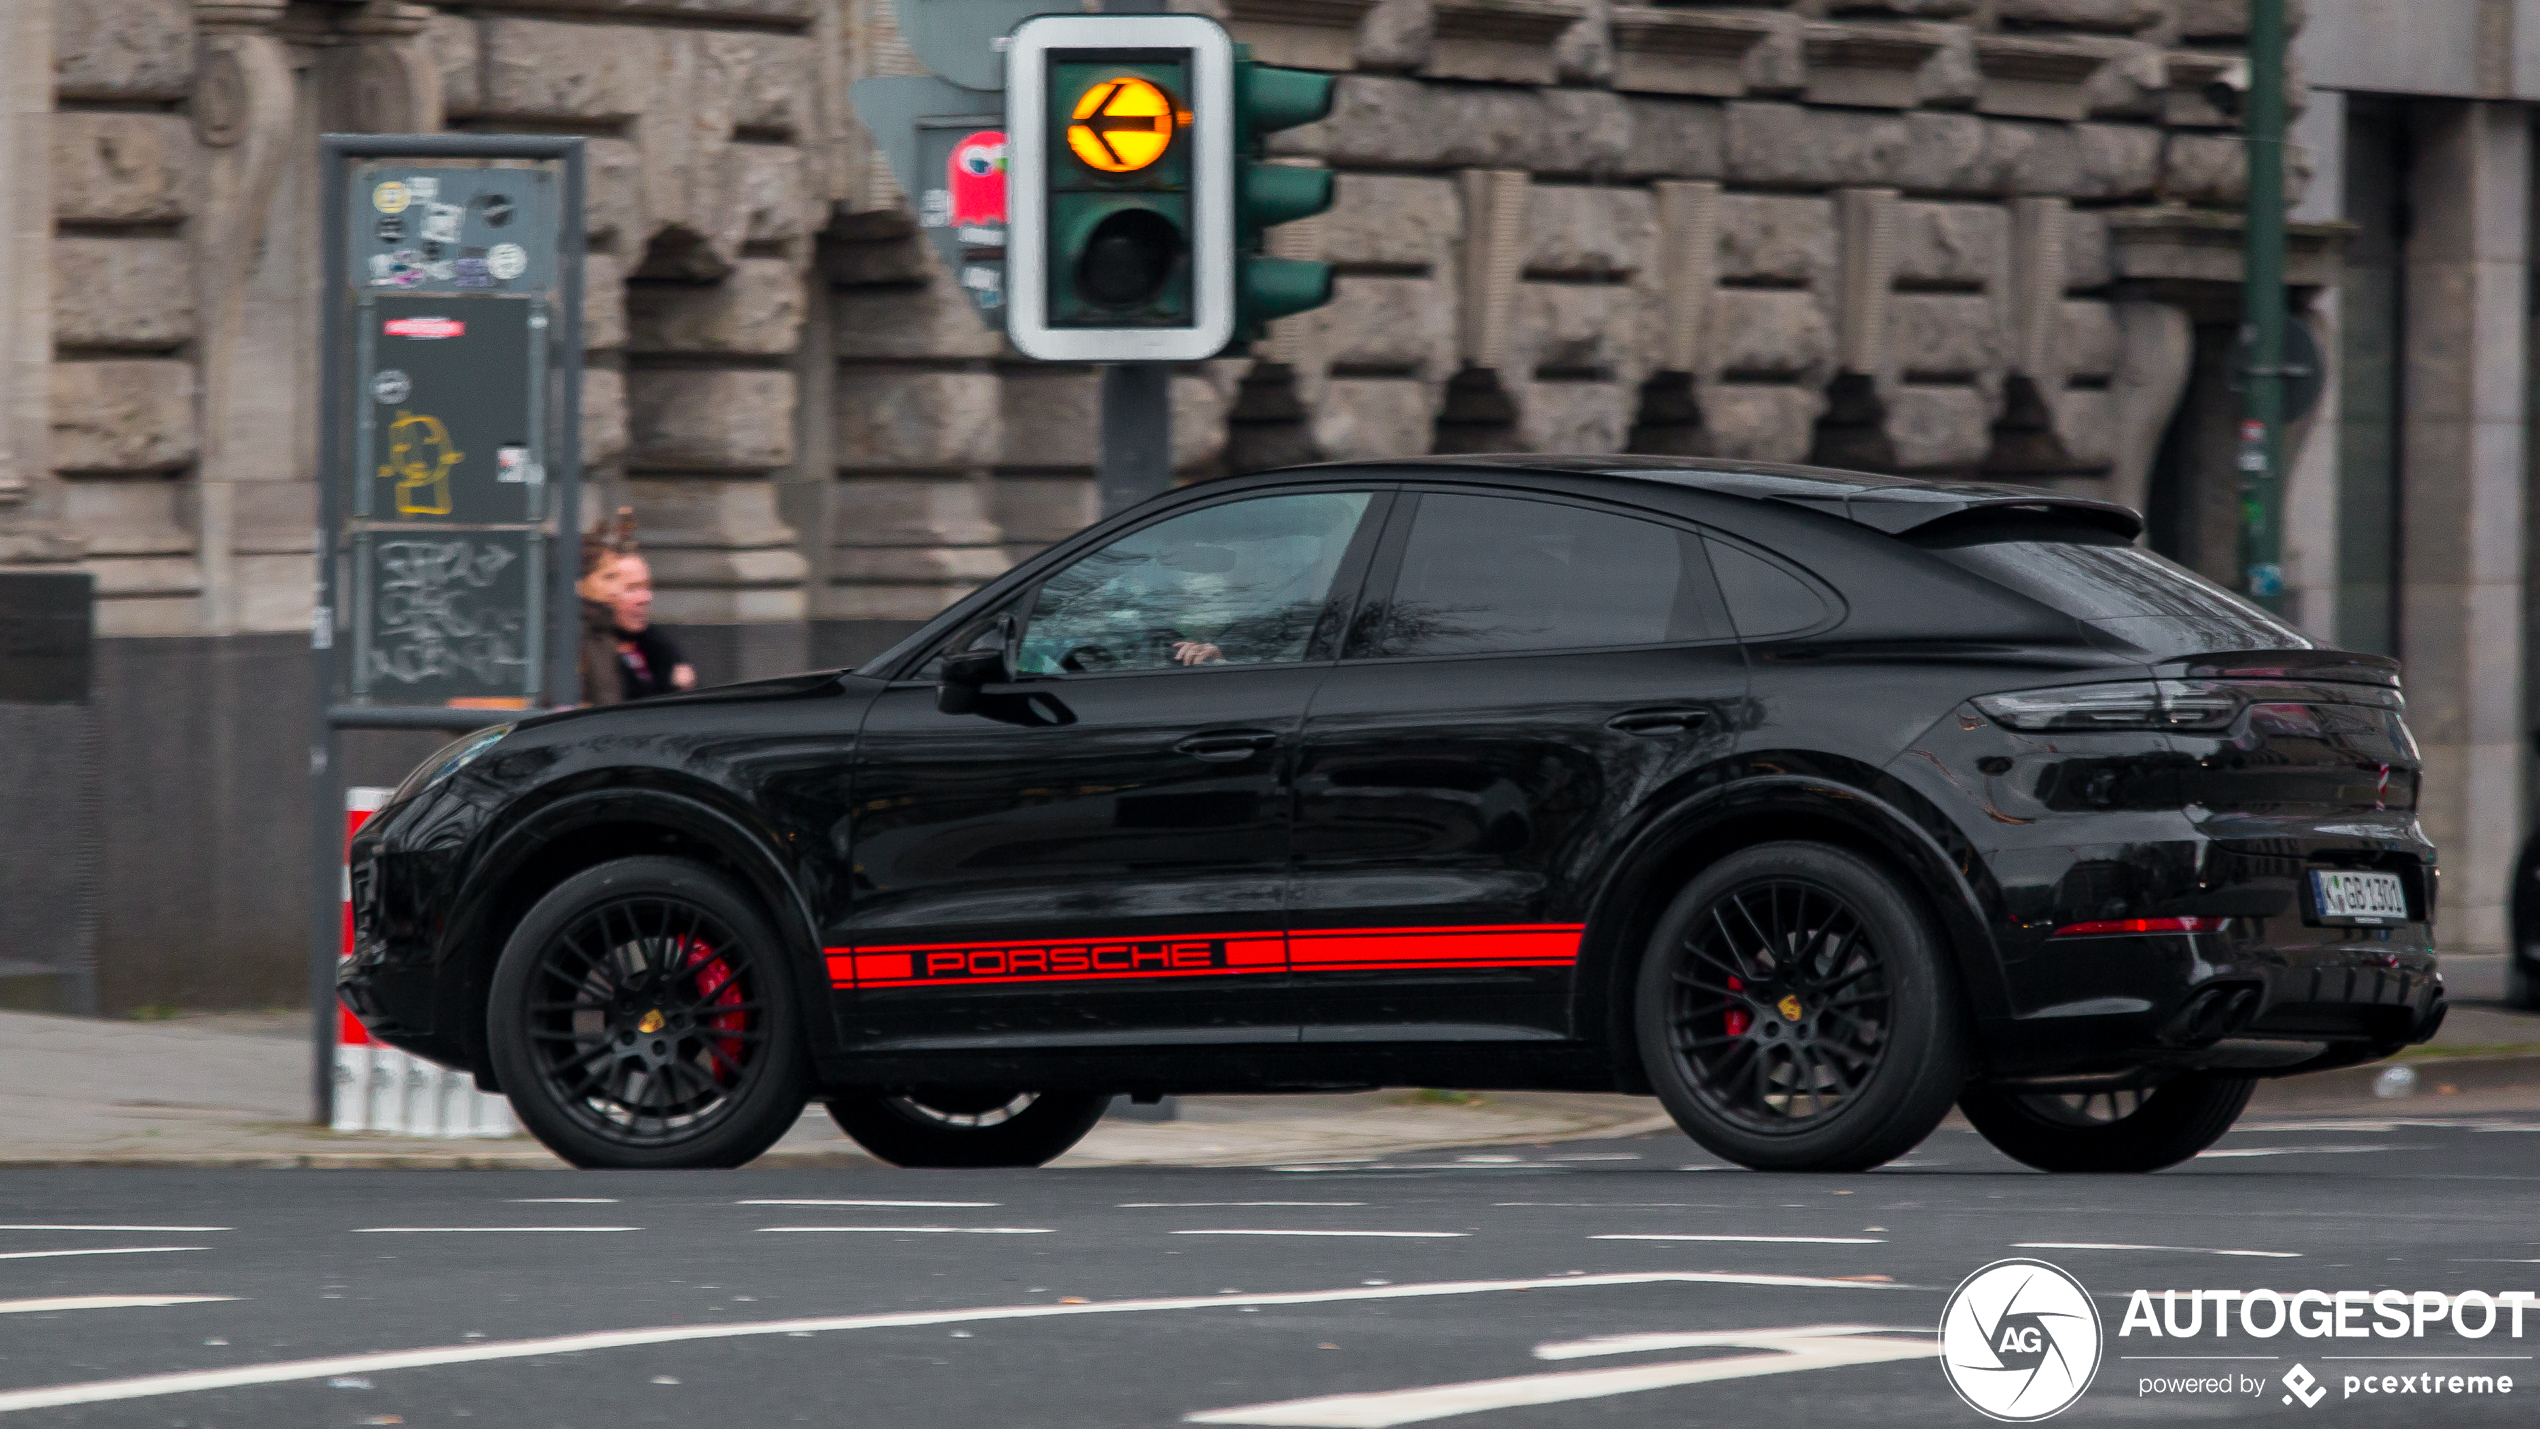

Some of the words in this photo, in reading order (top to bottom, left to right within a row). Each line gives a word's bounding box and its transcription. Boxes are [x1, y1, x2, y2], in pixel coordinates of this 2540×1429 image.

[2343, 876, 2367, 910] GB
[2366, 877, 2403, 913] 1301
[926, 942, 1213, 977] PORSCHE
